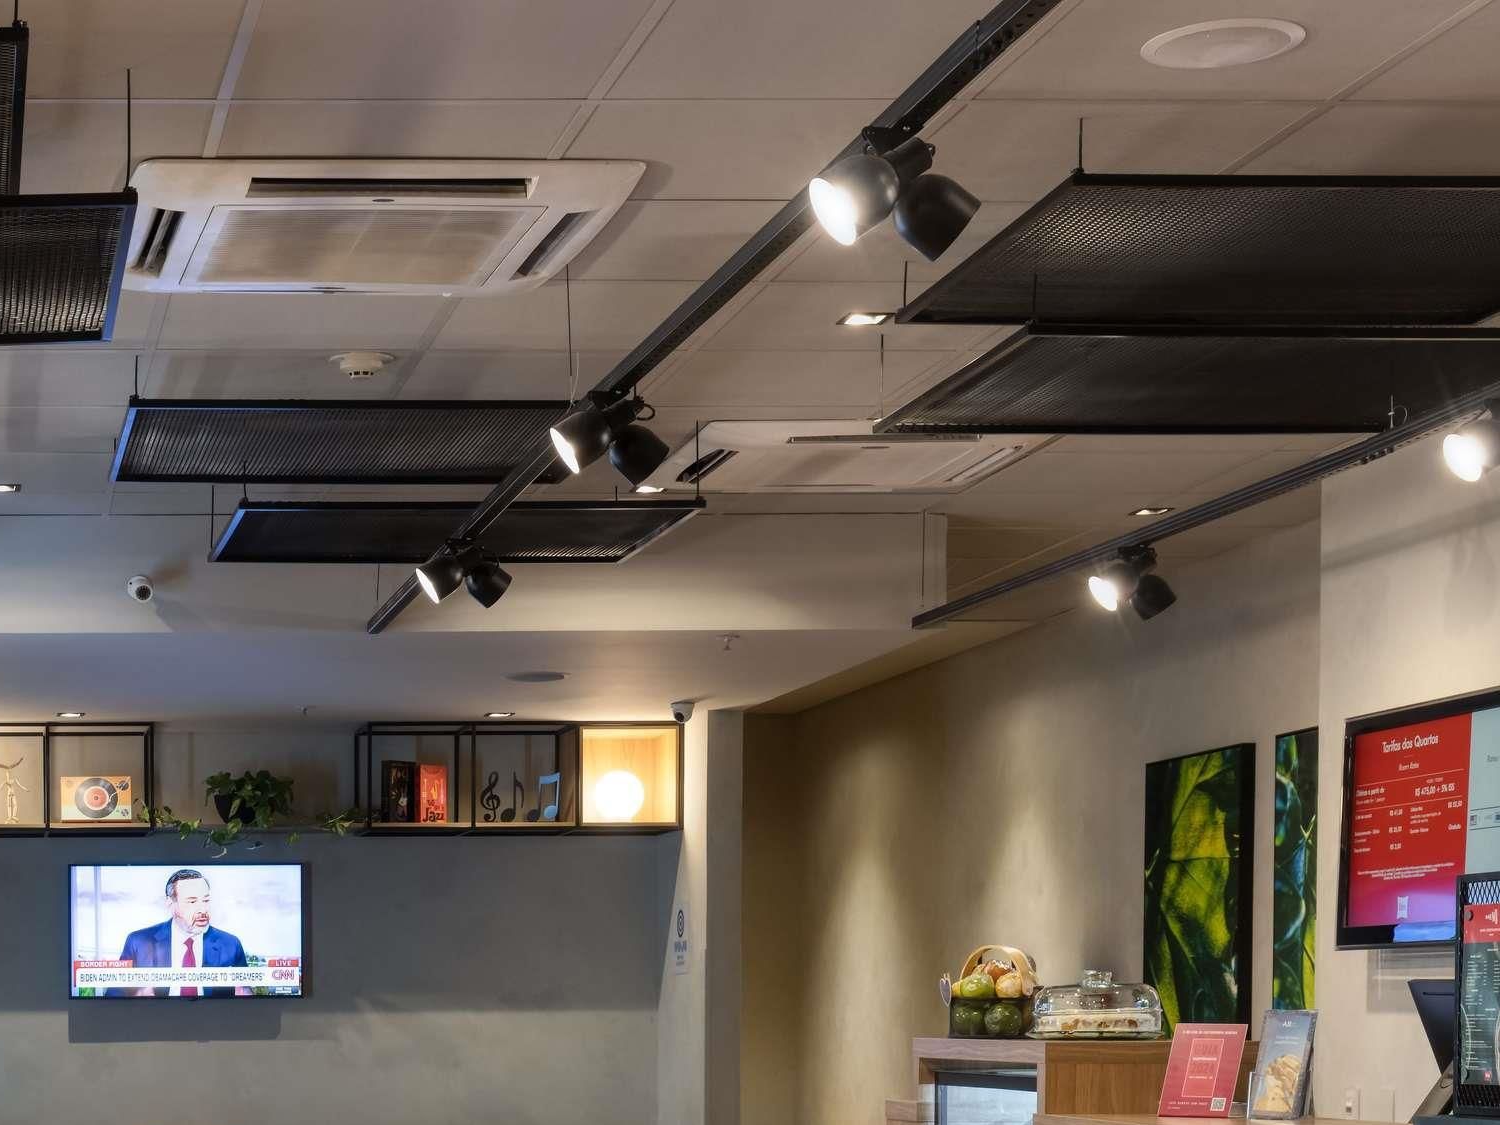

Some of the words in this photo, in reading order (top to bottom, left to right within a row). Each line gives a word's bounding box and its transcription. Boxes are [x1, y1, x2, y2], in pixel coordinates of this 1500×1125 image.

[1382, 739, 1401, 753] Tarifas
[1402, 738, 1413, 750] dos
[1414, 734, 1439, 748] Quartos
[80, 973, 97, 982] BIDEN
[99, 973, 117, 982] ADMIN
[119, 973, 127, 982] TO
[127, 973, 149, 982] EXTEND
[151, 973, 187, 982] OBAMACARE
[187, 973, 218, 982] COVERAGE
[220, 973, 228, 982] TO
[272, 969, 295, 980] CNN
